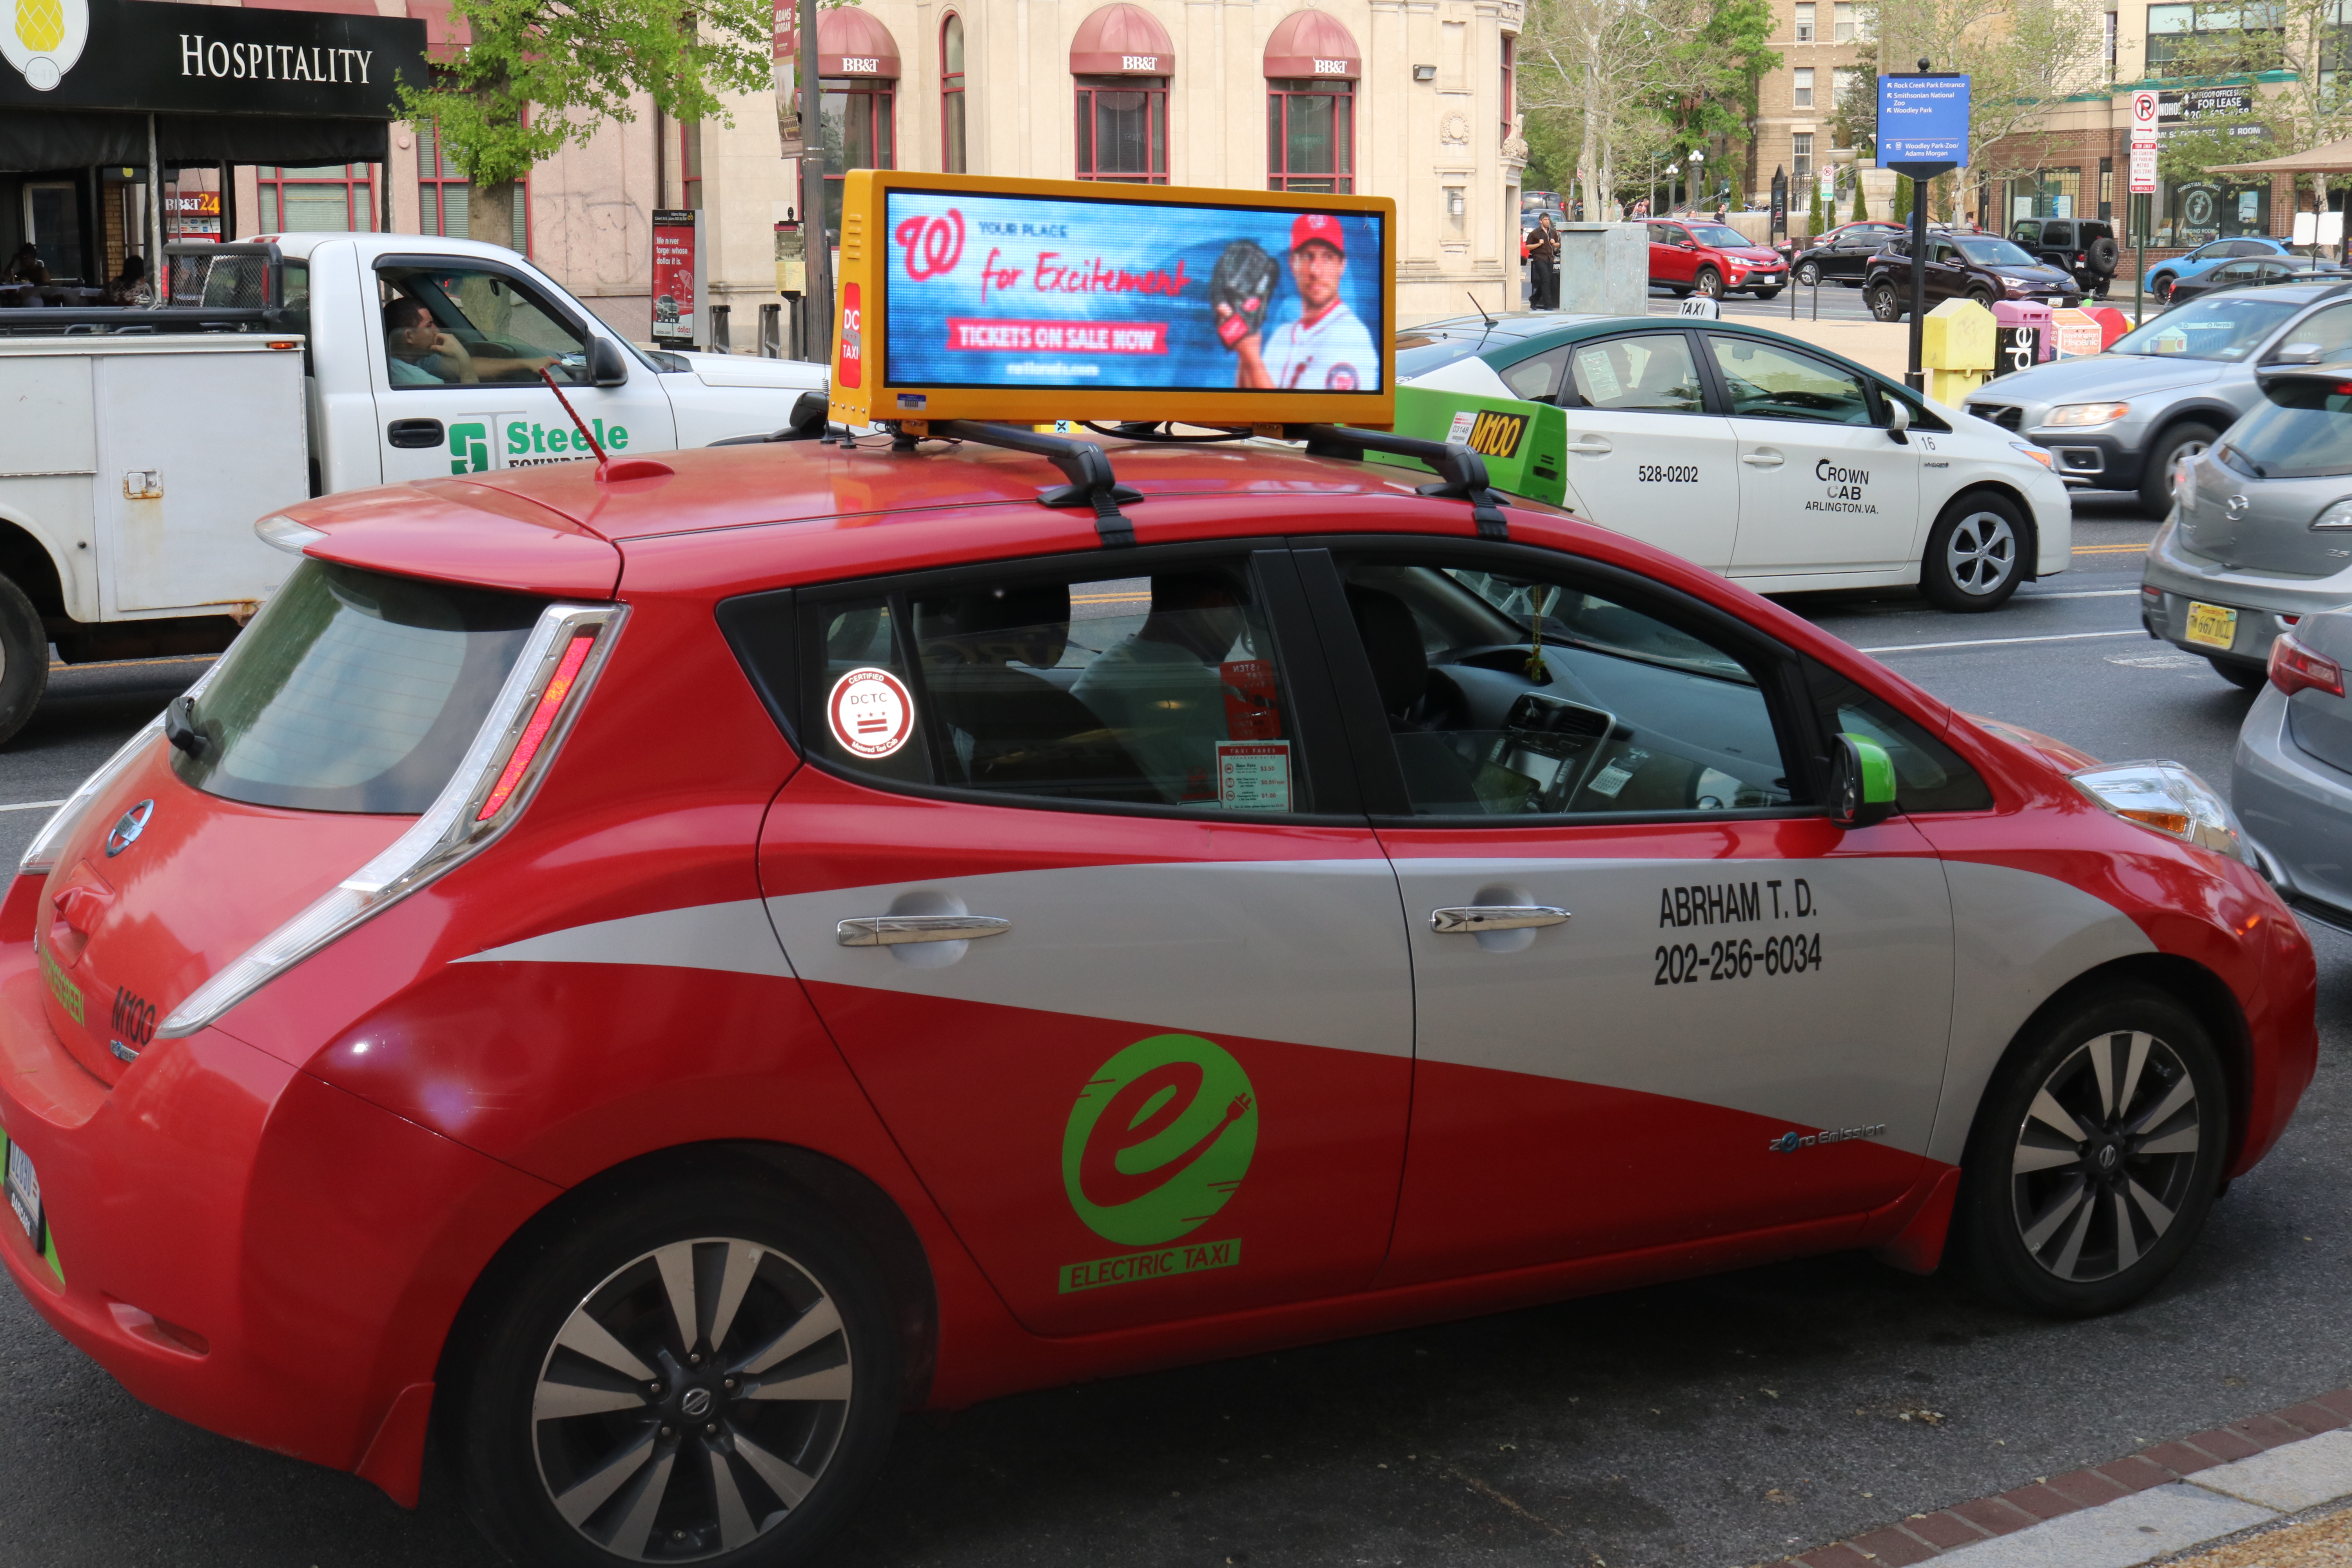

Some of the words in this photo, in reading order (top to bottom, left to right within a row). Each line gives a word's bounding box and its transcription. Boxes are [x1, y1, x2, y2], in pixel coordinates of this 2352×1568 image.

[775, 7, 791, 23] ADAMS
[775, 21, 791, 34] MORGAN
[180, 34, 372, 83] HOSPITALITY
[842, 58, 879, 73] BB&T
[1122, 56, 1158, 71] BB&T
[1314, 60, 1348, 74] BB&T
[2216, 89, 2233, 98] OFFICE
[2198, 98, 2215, 109] FOR
[2216, 97, 2242, 108] LEASE
[2237, 127, 2261, 135] ROOM
[2177, 181, 2201, 193] CHRISTIAN
[656, 246, 670, 256] forge
[656, 257, 671, 265] dolla
[981, 247, 1025, 306] for
[1034, 252, 1192, 297] Excitement
[1681, 302, 1706, 316] TAXI
[844, 309, 860, 330] DC
[958, 325, 1032, 348] TICKETS
[1034, 327, 1064, 348] ON
[1065, 328, 1109, 349] SALE
[1112, 330, 1157, 350] NOW
[2063, 338, 2099, 347] Hispanic
[842, 344, 858, 360] TAXI
[507, 418, 629, 455] Steele
[1452, 425, 1469, 434] 03148
[1468, 412, 1521, 457] M100
[1921, 436, 1936, 451] 16
[1639, 465, 1699, 483] 528-0202
[1816, 458, 1869, 485] CROWN
[1827, 485, 1862, 501] CAB
[848, 673, 885, 684] CERTIFIED
[850, 692, 888, 705] DCTC
[851, 741, 875, 753] Metered
[875, 744, 887, 753] Taxi
[886, 738, 898, 748] Cab
[1659, 881, 1760, 928] ABRHAM
[1768, 879, 1789, 919] T.
[1794, 878, 1818, 917] D.
[1654, 933, 1822, 986] 202-256-6034
[111, 985, 156, 1046] M100
[1769, 1132, 1817, 1154] zero
[1818, 1123, 1886, 1144] Emission
[11, 1191, 30, 1238] DARCARS
[1070, 1252, 1174, 1289] ELECTRIC
[1183, 1243, 1230, 1270] TAXI
